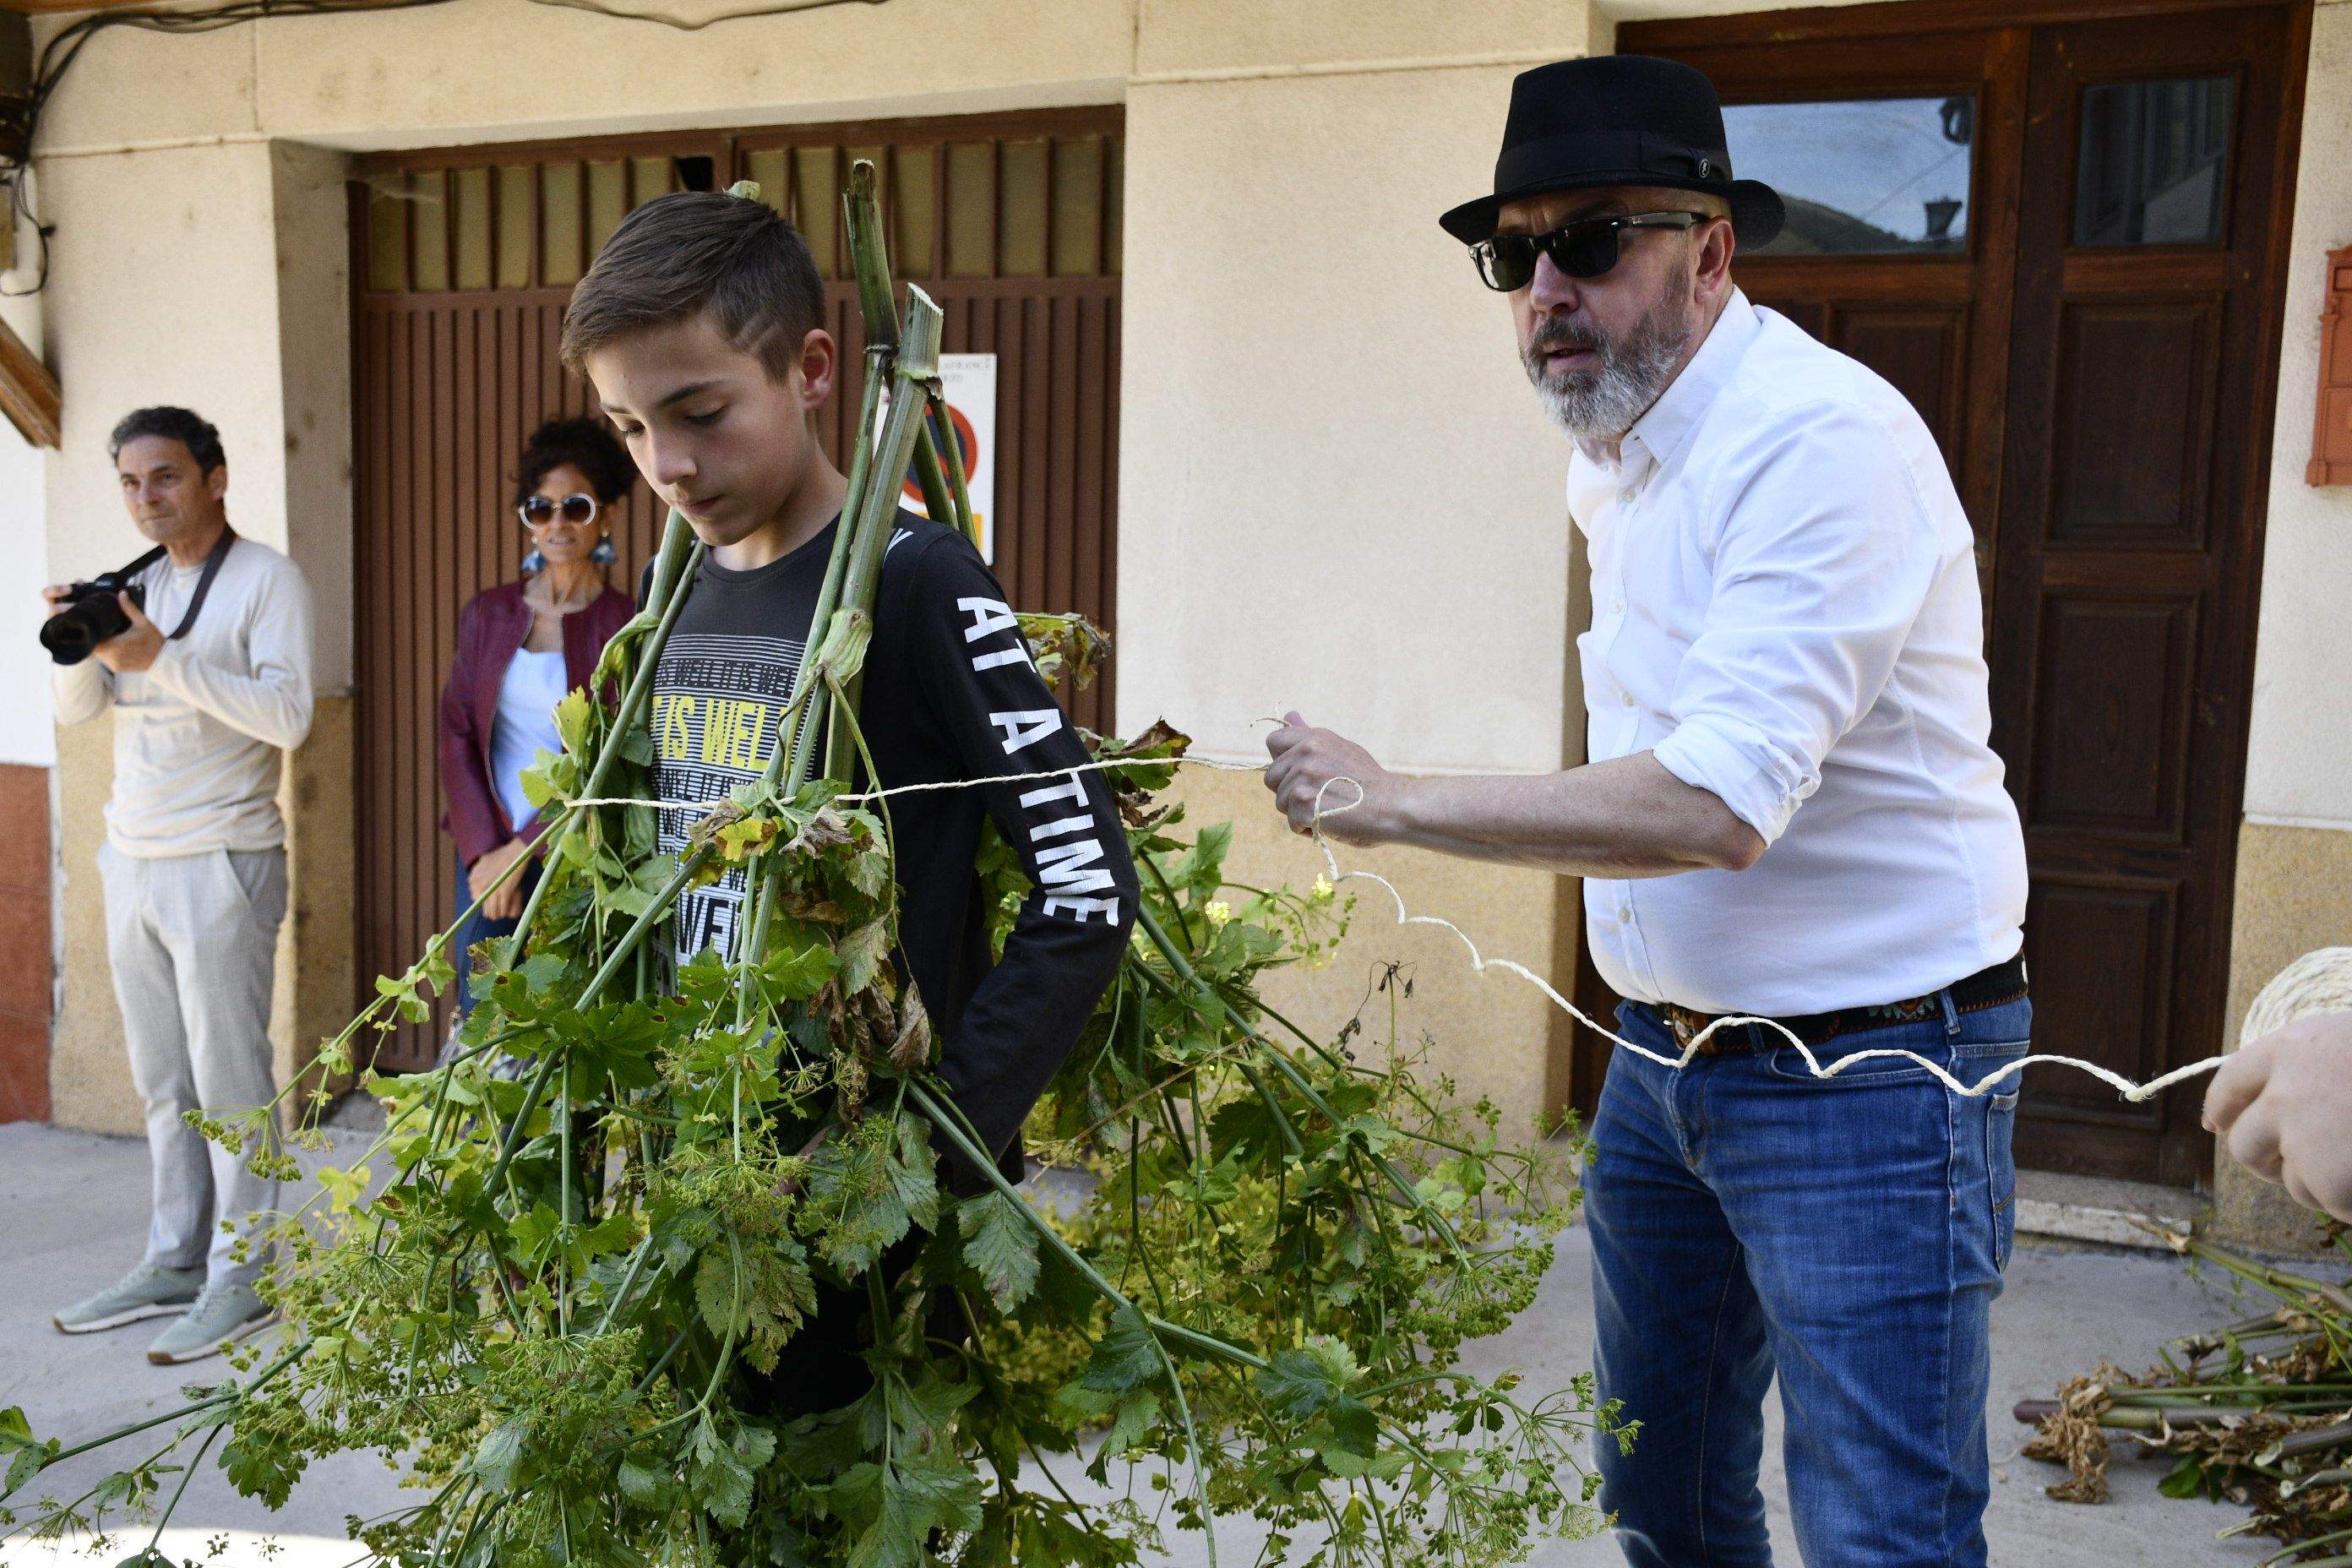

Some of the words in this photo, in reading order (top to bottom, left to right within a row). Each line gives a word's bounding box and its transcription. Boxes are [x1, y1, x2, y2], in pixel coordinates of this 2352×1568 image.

[957, 596, 1037, 674] AT
[662, 694, 695, 761] IS
[701, 698, 788, 772] WEL
[989, 708, 1063, 755] A
[1019, 770, 1120, 928] TIME
